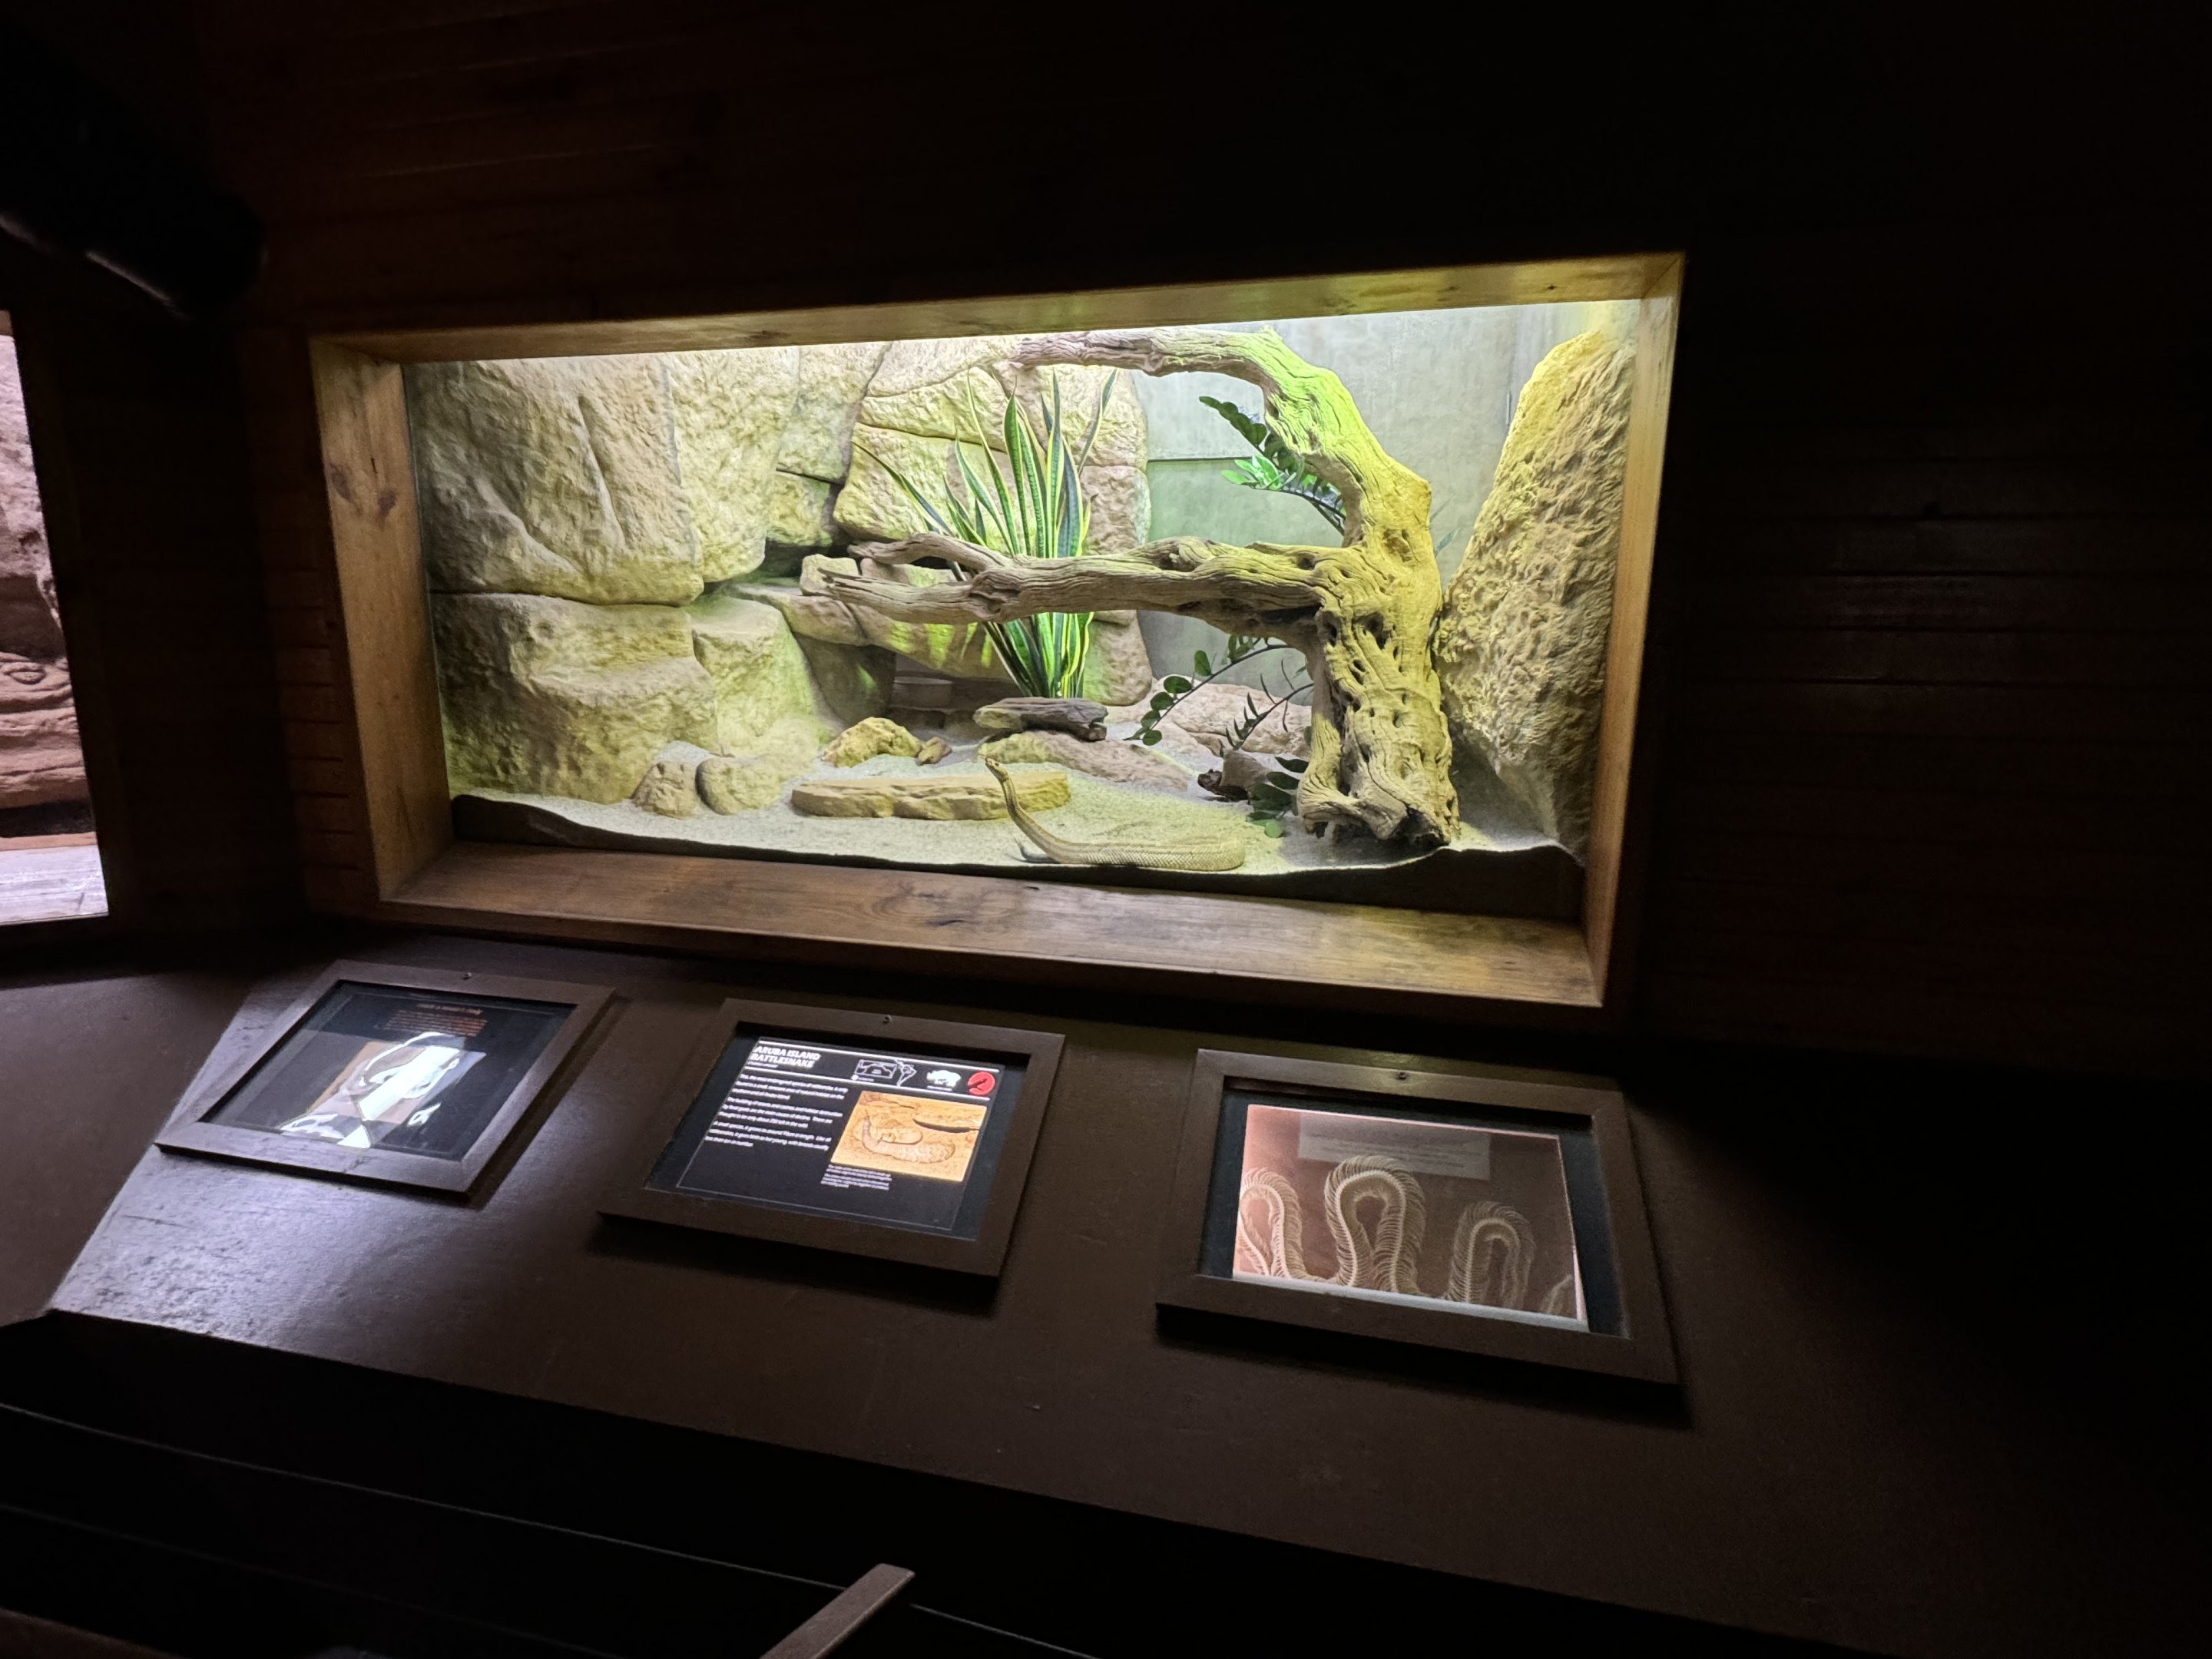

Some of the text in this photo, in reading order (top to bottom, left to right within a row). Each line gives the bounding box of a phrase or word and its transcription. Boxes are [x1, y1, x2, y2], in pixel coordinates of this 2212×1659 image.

[753, 1046, 821, 1060] ARUBA ISLAND
[750, 1053, 816, 1068] RATTLESNAKE
